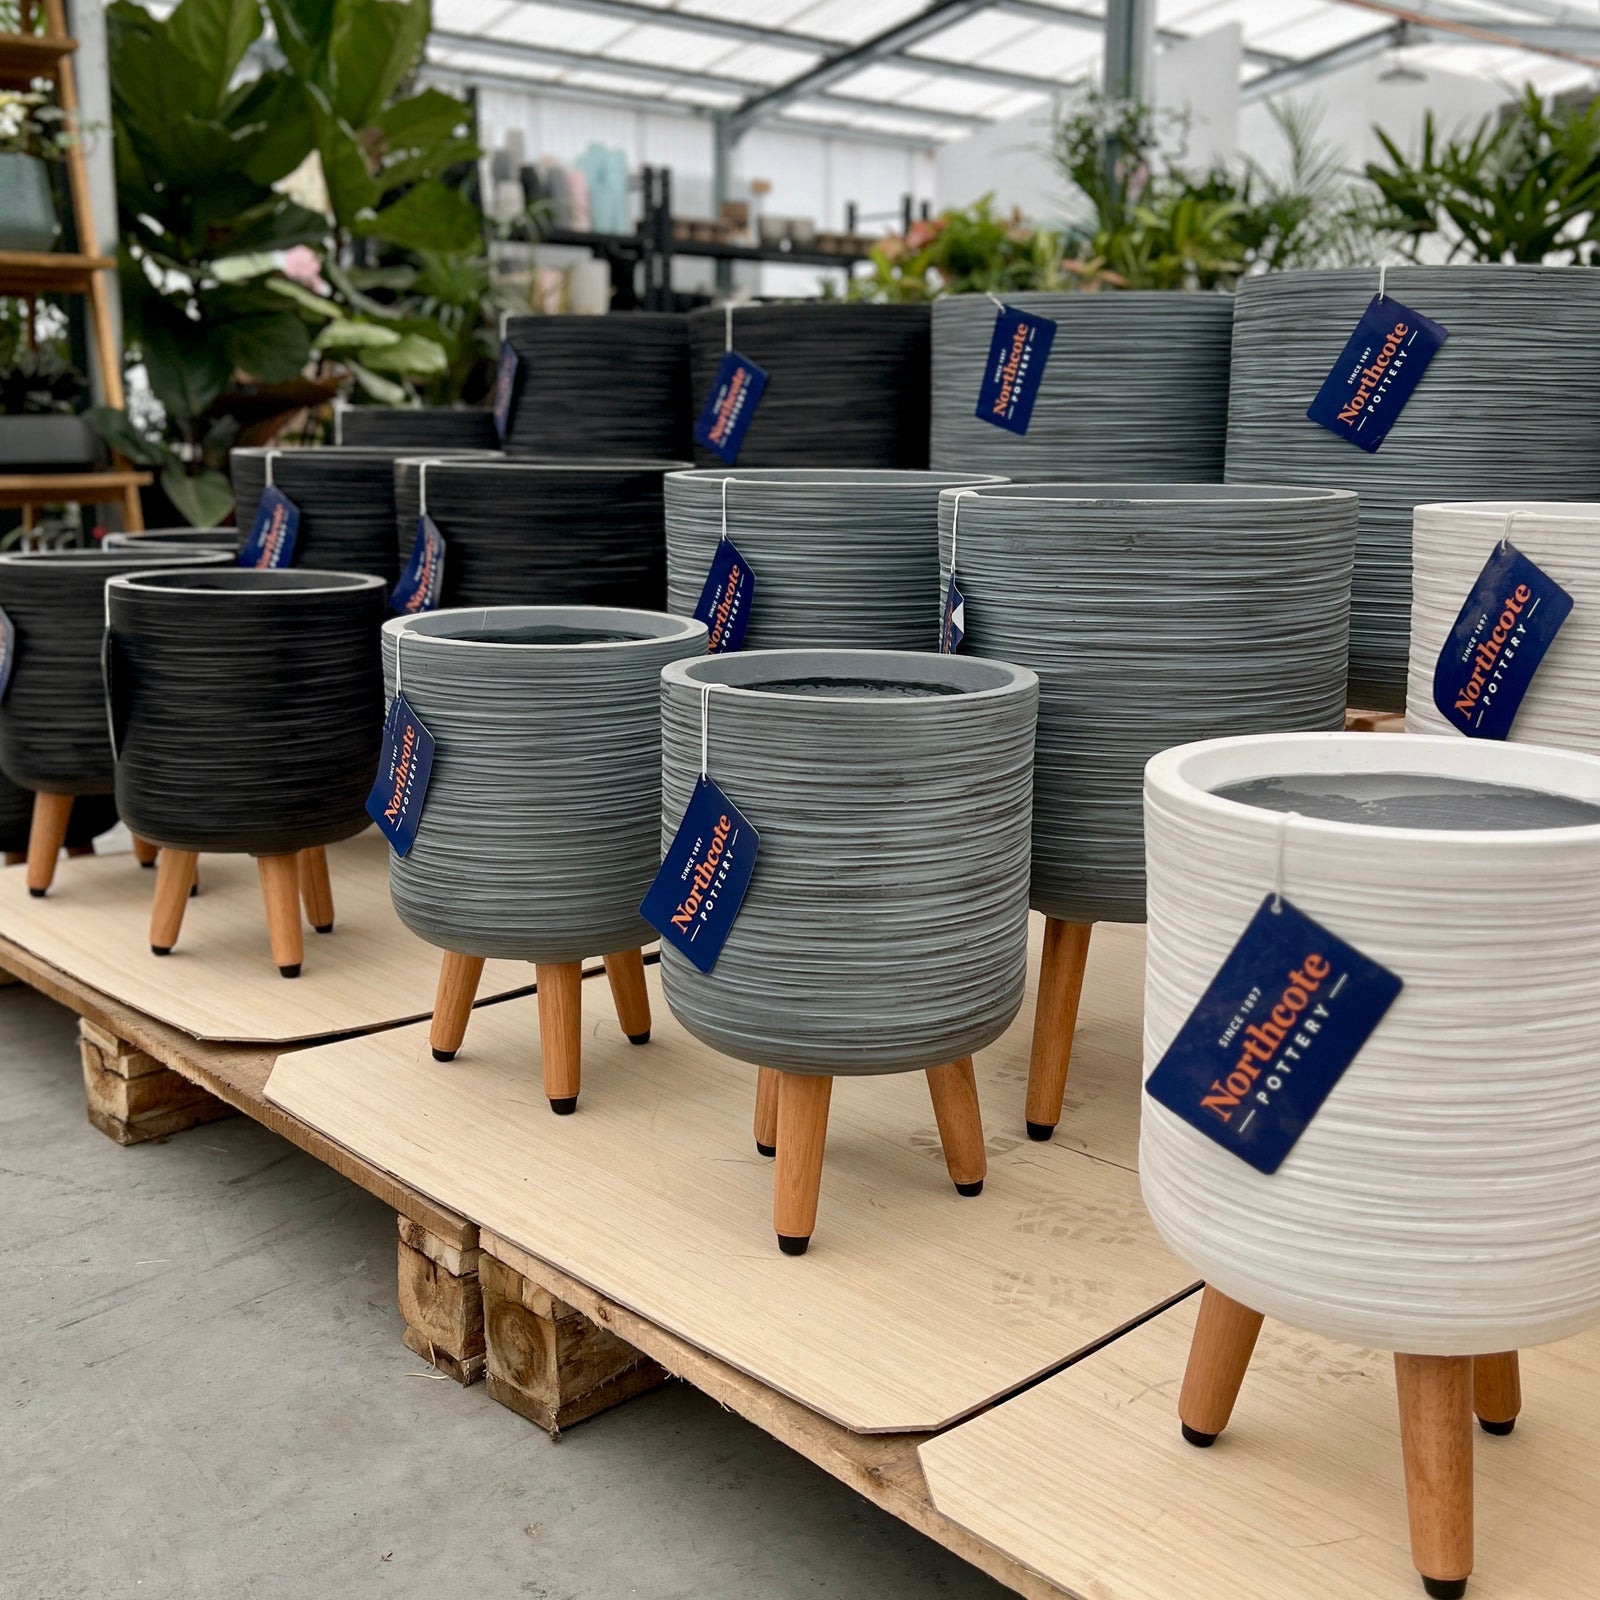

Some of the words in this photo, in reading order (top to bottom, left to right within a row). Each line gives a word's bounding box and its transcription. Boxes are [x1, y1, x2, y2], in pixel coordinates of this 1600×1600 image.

[993, 323, 1028, 416] Northcote
[1012, 345, 1032, 402] POTTERY
[1337, 323, 1409, 427] Northcote
[1348, 365, 1361, 384] SINCE
[1360, 347, 1372, 363] 1897
[1367, 350, 1408, 412] POTTERY
[721, 591, 741, 647] POTTERY
[1454, 583, 1532, 721] Northcote
[1461, 637, 1477, 663] SINCE
[1475, 613, 1488, 635] 1897
[1483, 623, 1527, 706] POTTERY
[384, 724, 415, 826] Northcote
[401, 753, 419, 814] POTTERY
[670, 814, 732, 935] Northcote
[680, 858, 695, 881] SINCE
[692, 837, 704, 857] 1897
[700, 849, 734, 921] POTTERY
[1200, 953, 1331, 1123] Northcote
[1218, 1014, 1245, 1048] SINCE
[1240, 986, 1263, 1015] 1897
[1256, 1004, 1330, 1105] POTTERY
